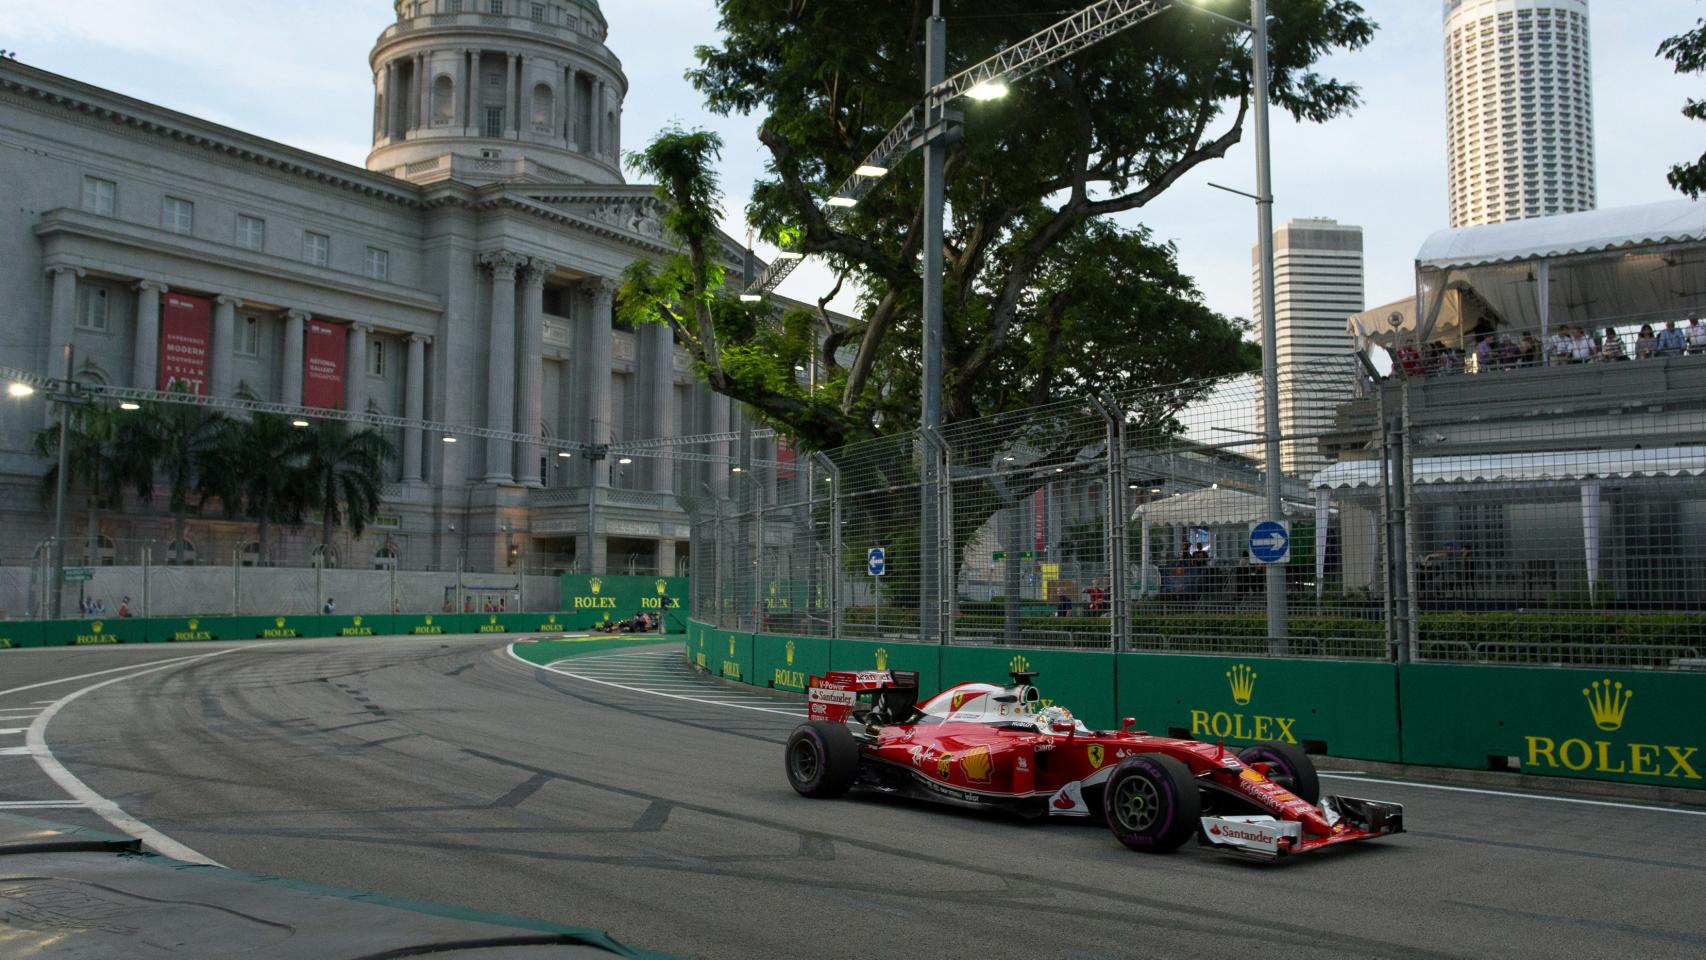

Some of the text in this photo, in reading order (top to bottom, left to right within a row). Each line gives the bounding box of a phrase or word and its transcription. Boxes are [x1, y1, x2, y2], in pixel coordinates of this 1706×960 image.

[167, 344, 205, 356] MODERN
[167, 355, 204, 366] SOUTHEAST
[310, 358, 336, 368] NATIONAL
[167, 365, 204, 376] ASIAN
[310, 365, 334, 374] GALLERY
[574, 597, 616, 609] ROLEX
[264, 628, 296, 638] ROLEX
[343, 627, 372, 636] ROLEX
[415, 626, 442, 634] ROLEX
[480, 625, 505, 633] ROLEX
[541, 624, 564, 632] ROLEX
[76, 634, 118, 645] ROLEX
[175, 631, 211, 641] ROLEX
[723, 660, 740, 678] ROLEX
[775, 668, 805, 689] ROLEX
[819, 680, 845, 691] V-Power
[819, 690, 852, 704] Santander
[1191, 709, 1298, 745] ROLEX
[1034, 743, 1056, 753] Claro
[1222, 757, 1241, 768] 5
[1524, 735, 1702, 780] ROLEX
[1222, 825, 1273, 845] Santander
